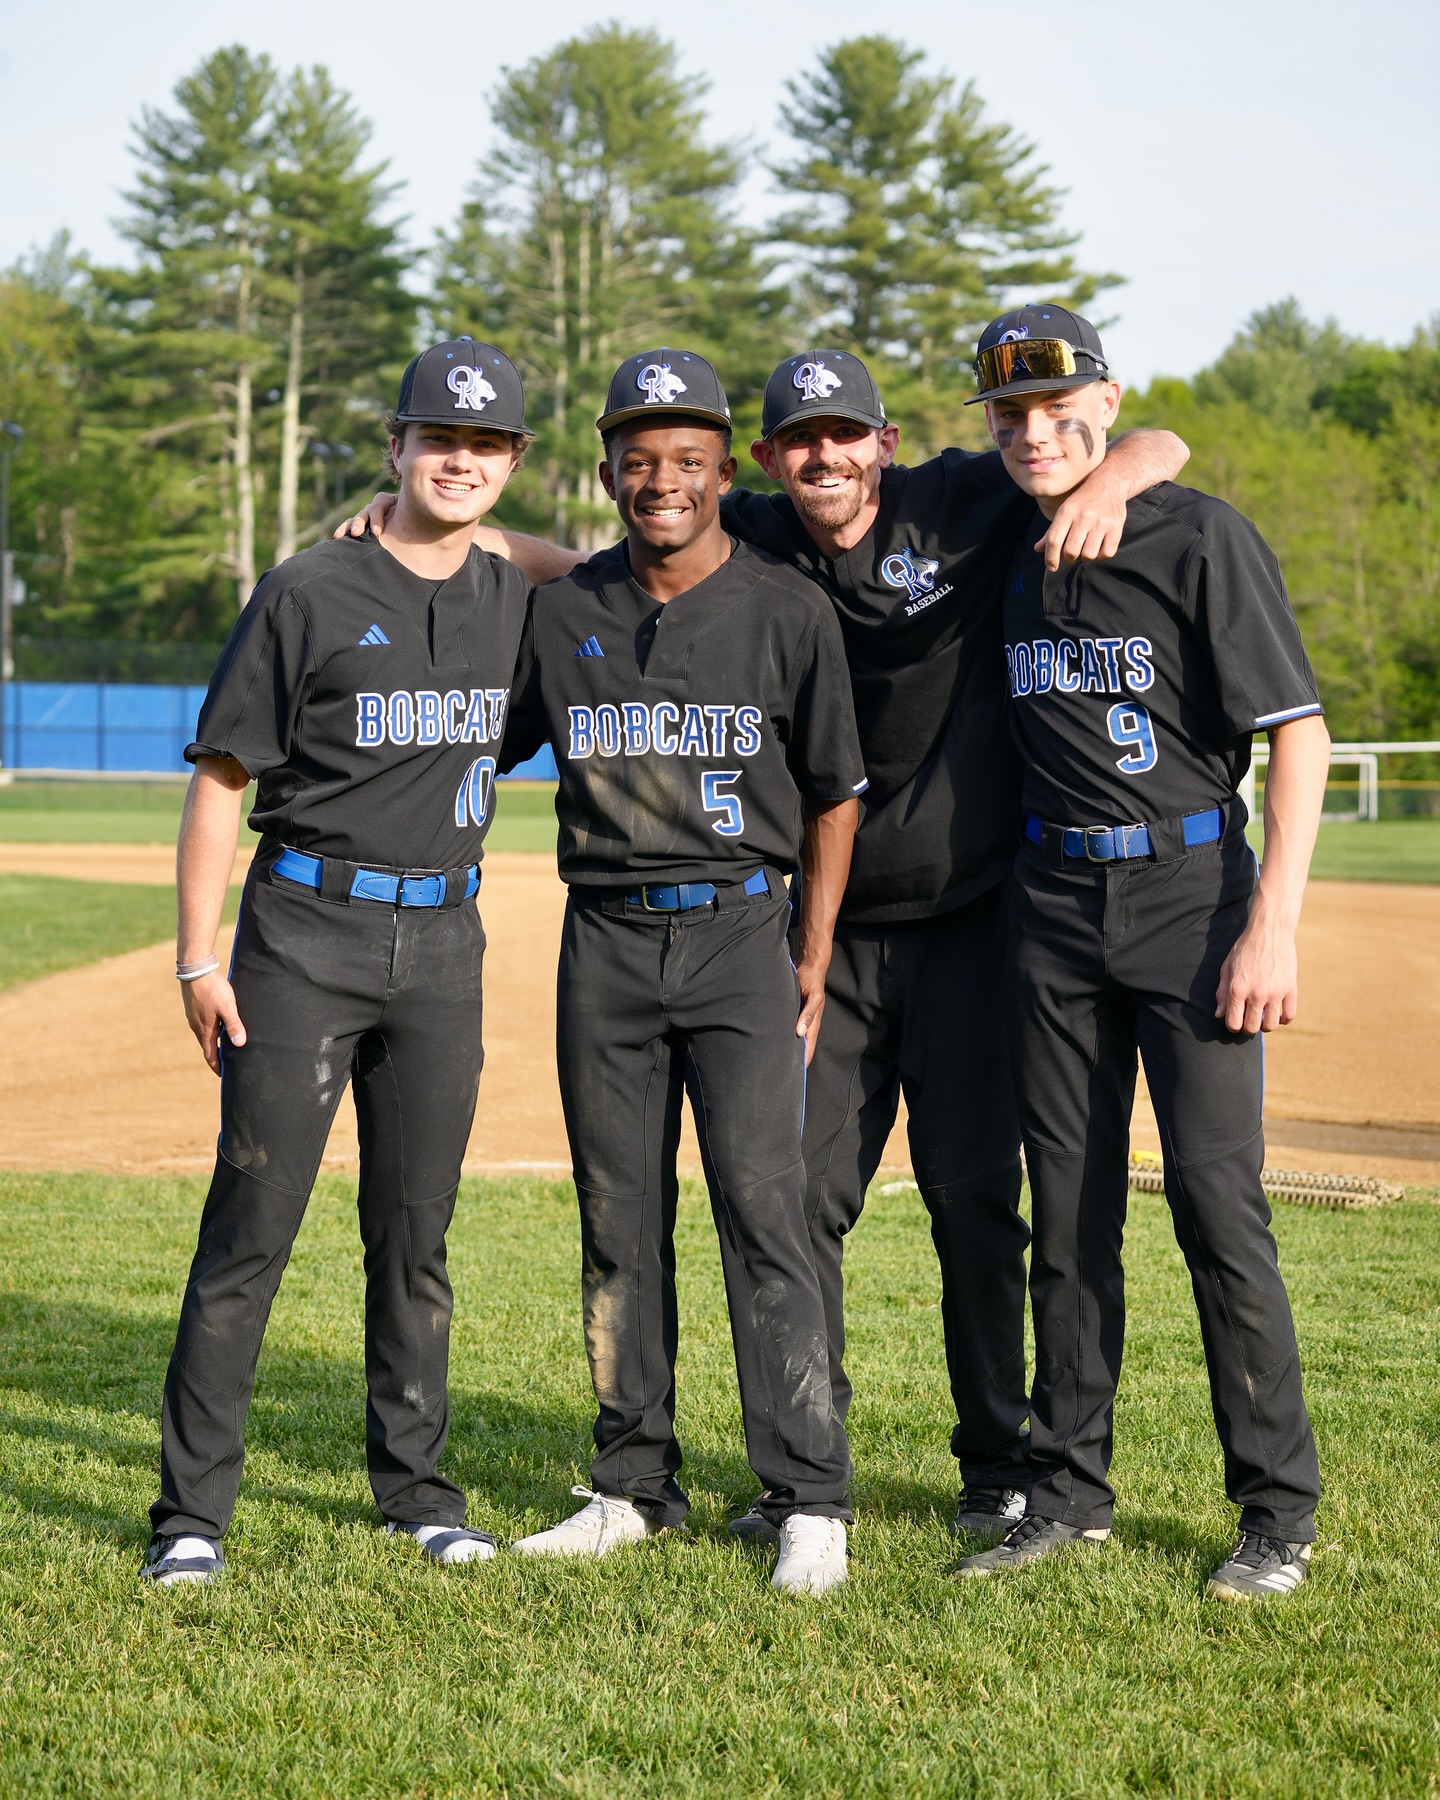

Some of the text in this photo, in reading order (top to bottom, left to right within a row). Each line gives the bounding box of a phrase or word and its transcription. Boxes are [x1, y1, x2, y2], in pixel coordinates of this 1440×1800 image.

[904, 582, 954, 617] BASEBALL
[567, 701, 762, 759] BOBCATS
[1106, 701, 1158, 774] 9
[455, 756, 497, 827] 10
[701, 770, 743, 836] 5
